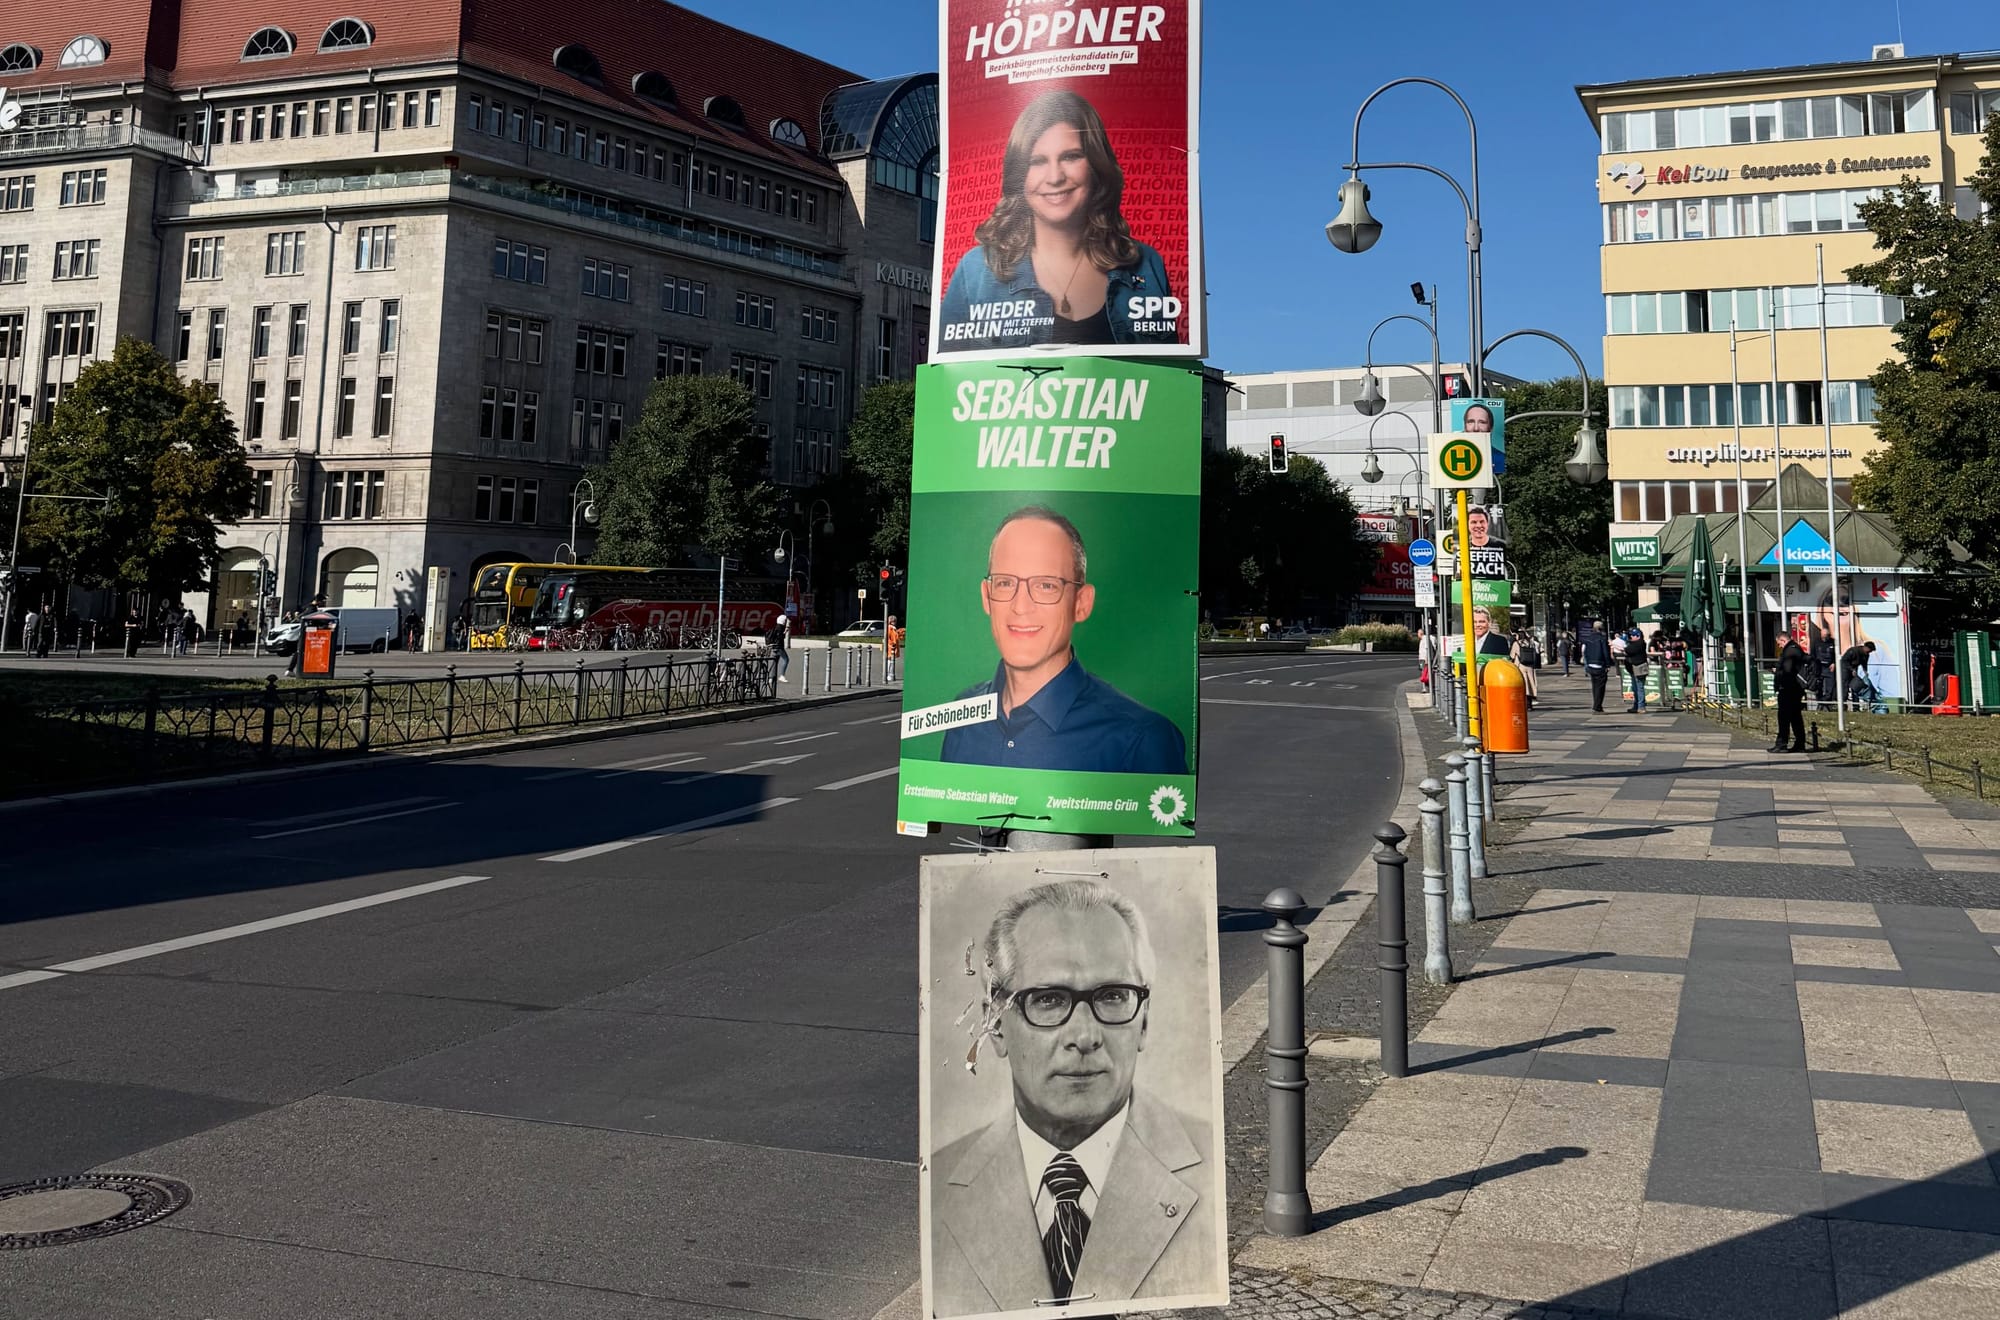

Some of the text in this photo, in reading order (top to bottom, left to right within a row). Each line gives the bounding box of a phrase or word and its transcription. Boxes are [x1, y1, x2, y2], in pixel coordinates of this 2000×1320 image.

[965, 6, 1166, 62] HÖPPNER
[988, 52, 1118, 73] Bezirksbürgermeisterkandidatin
[1119, 51, 1135, 62] für
[1011, 63, 1106, 79] Tempelhof-Schöneberg
[1657, 155, 1931, 184] KelCon Congresses & Conferences
[876, 262, 933, 293] KAUFHA
[970, 300, 1036, 321] WIEDER
[1128, 296, 1182, 319] SPD
[944, 317, 1055, 341] BERLIN MIT STEFFEN
[1002, 327, 1030, 337] KRACH
[1133, 321, 1176, 332] BERLIN
[953, 377, 1150, 422] SEBASTIAN
[977, 425, 1117, 469] WALTER
[1614, 541, 1656, 557] WITTY'S
[1787, 547, 1832, 560] kiosk
[908, 699, 992, 731] Für Schöneberg!
[904, 784, 1019, 805] Erststimme Sebastian Walter
[1046, 796, 1139, 811] Zweitstimme Grün
